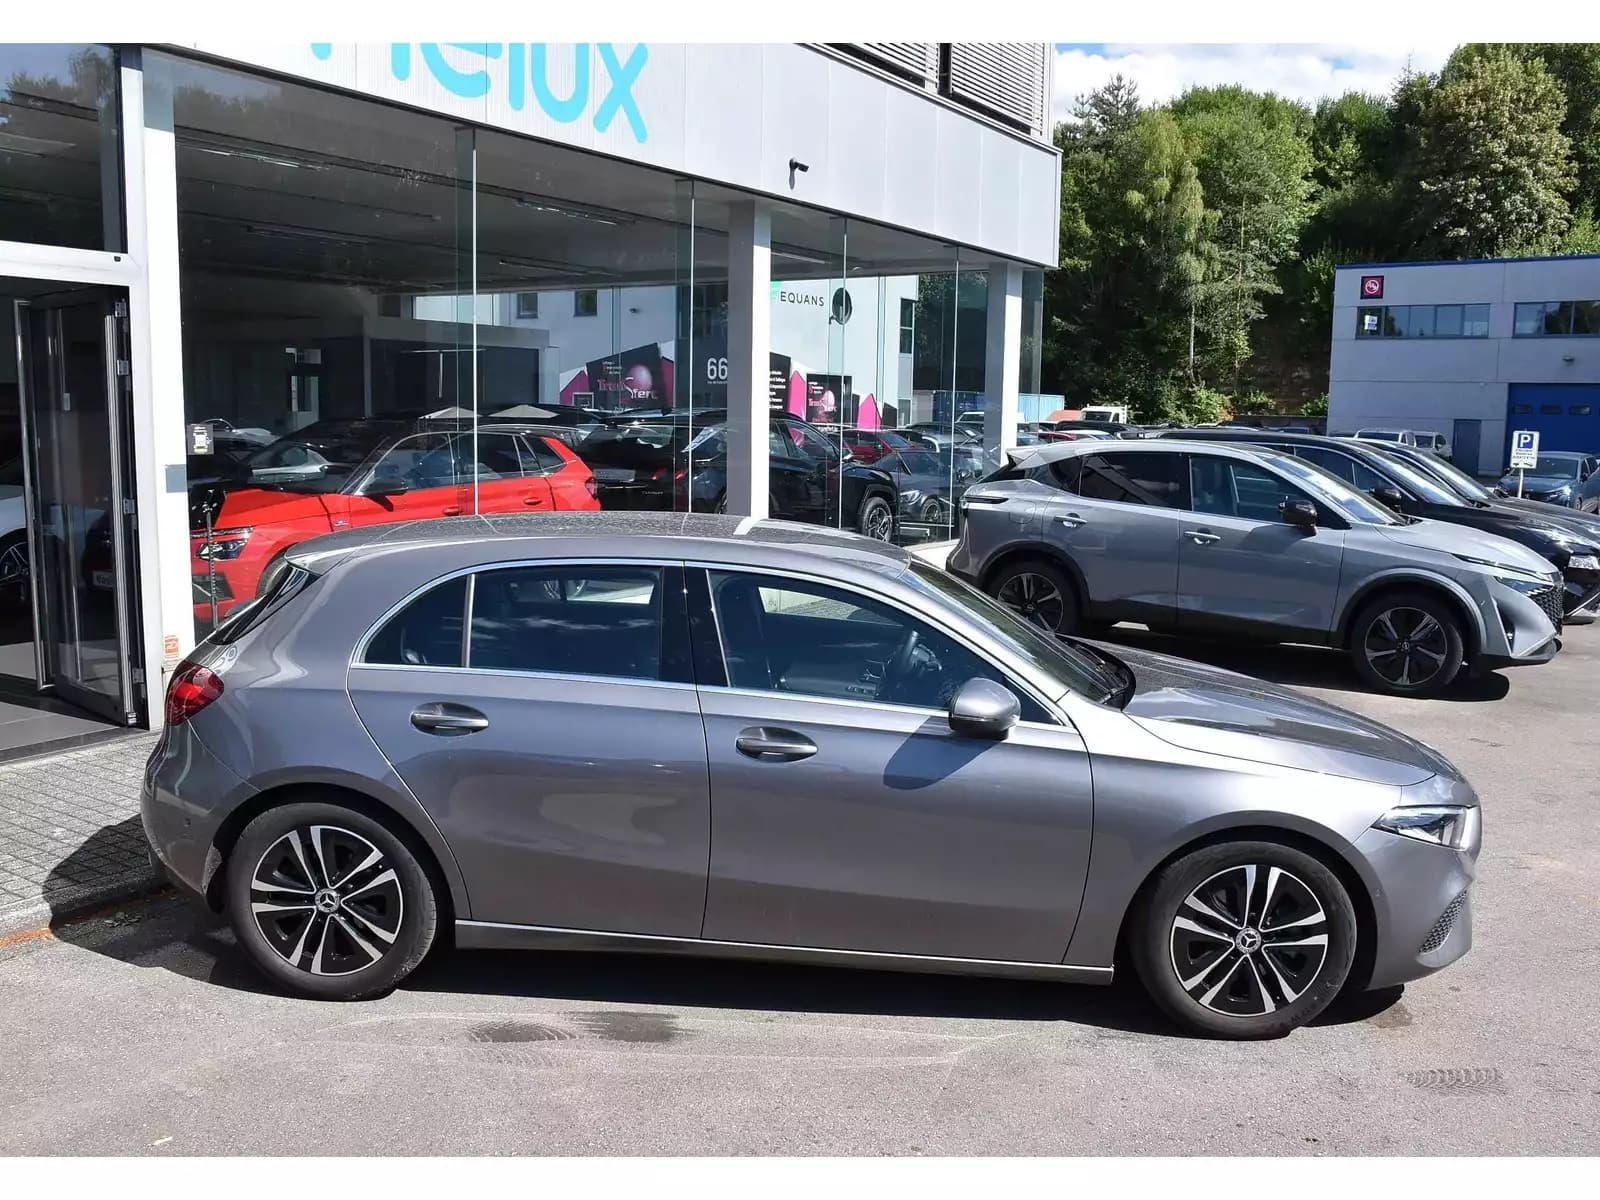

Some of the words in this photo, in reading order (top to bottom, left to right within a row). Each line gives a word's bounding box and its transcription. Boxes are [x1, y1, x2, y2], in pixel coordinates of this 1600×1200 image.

[780, 291, 825, 307] EQUANS
[707, 357, 728, 380] 66
[1520, 434, 1531, 448] P
